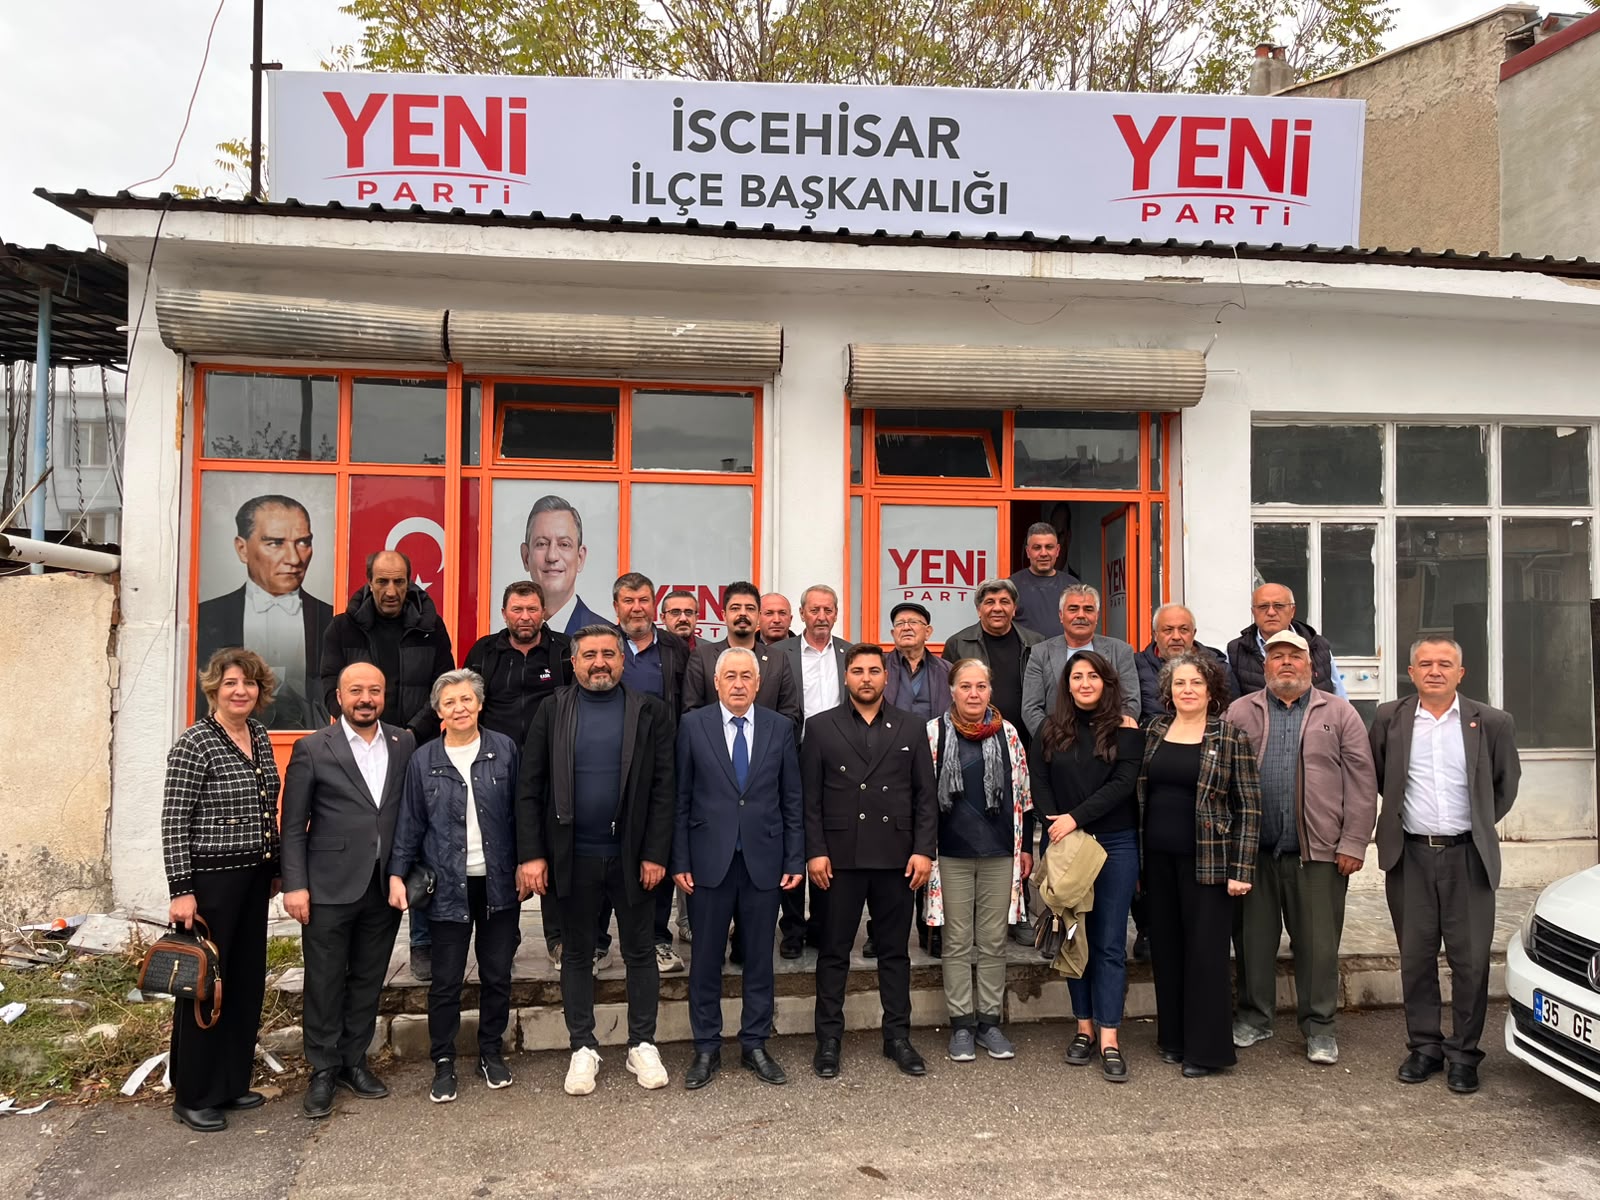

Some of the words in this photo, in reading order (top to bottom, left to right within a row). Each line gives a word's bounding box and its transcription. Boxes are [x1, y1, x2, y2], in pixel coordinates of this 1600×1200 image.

[672, 97, 960, 159] İSCEHİSAR
[631, 162, 723, 217] İLÇE
[740, 170, 1008, 220] BAŞKANLIĞI
[904, 591, 967, 601] PART
[1107, 556, 1126, 595] YEN
[1543, 999, 1559, 1027] 35
[1573, 1013, 1592, 1044] GE
